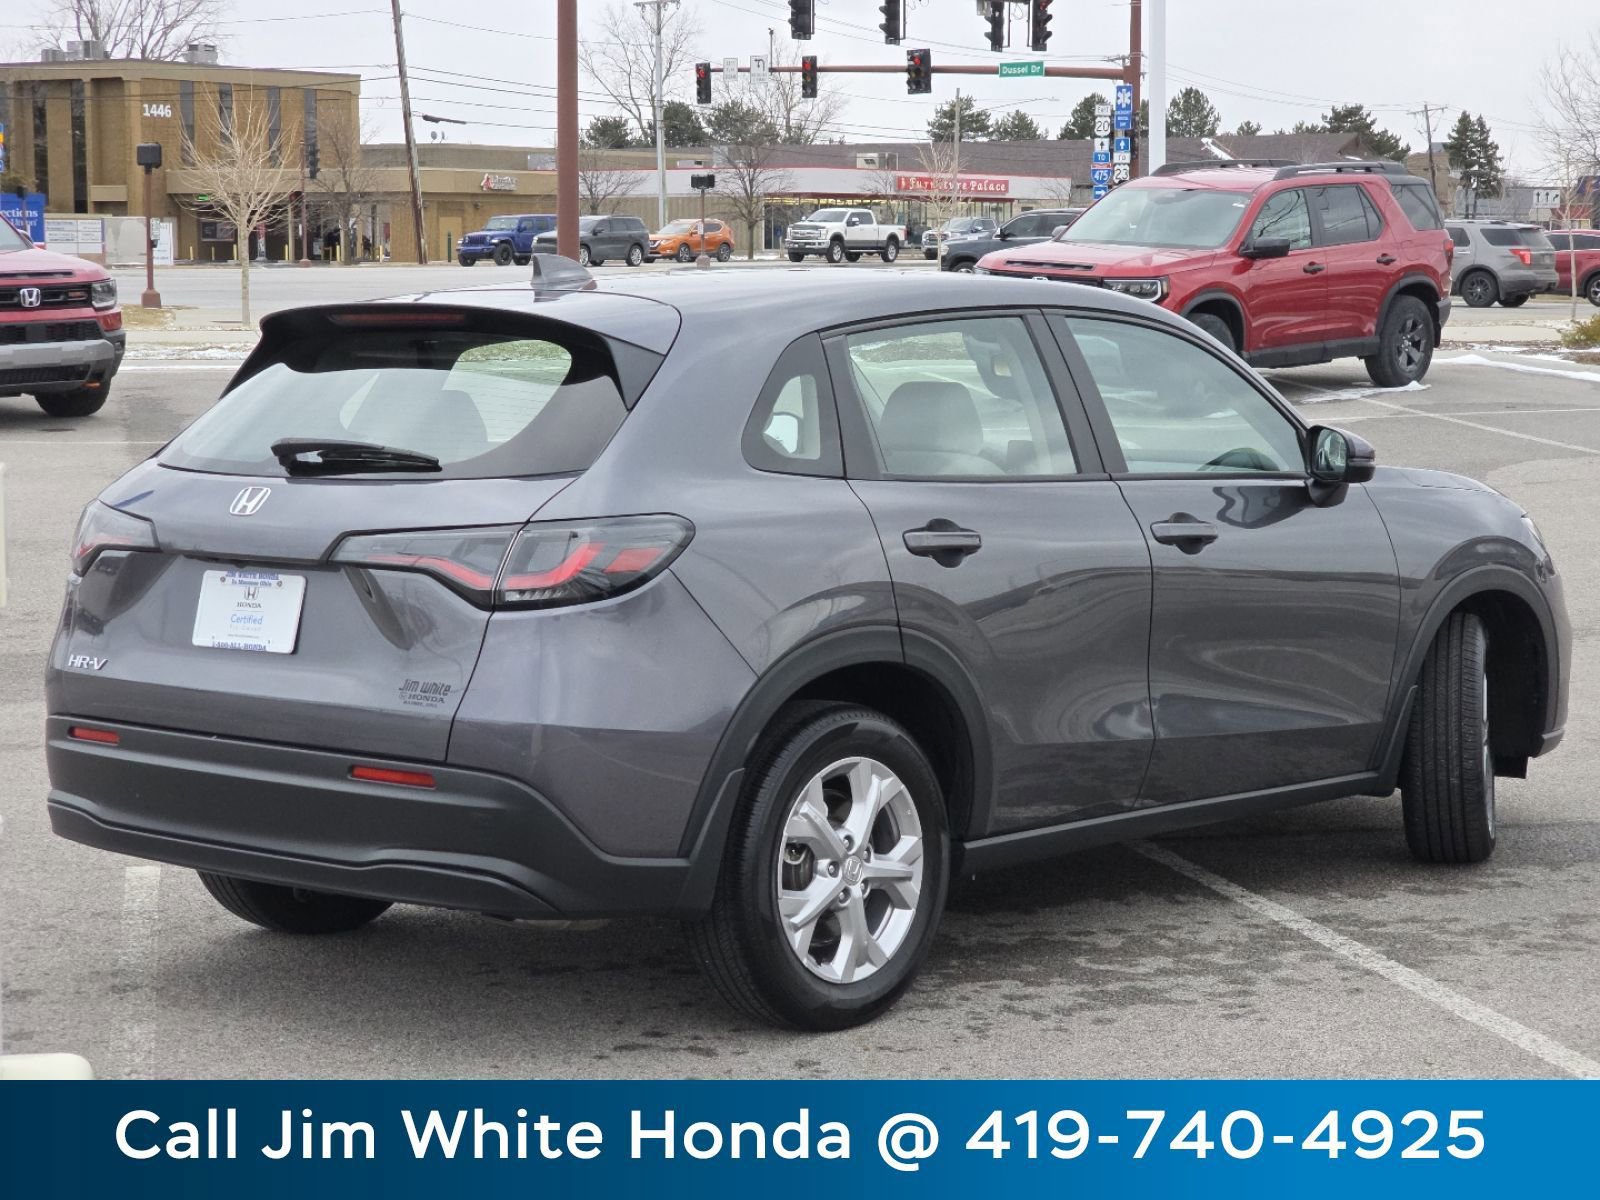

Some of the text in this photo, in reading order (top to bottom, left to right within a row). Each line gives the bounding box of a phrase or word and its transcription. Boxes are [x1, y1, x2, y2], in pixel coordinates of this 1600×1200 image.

[1002, 65, 1041, 75] Dussel Dr
[142, 104, 172, 118] 1446
[1096, 120, 1110, 132] 20
[1097, 153, 1106, 161] TO
[1094, 169, 1108, 179] 475
[1115, 168, 1129, 180] 23
[909, 177, 1006, 191] Furture Palace
[237, 601, 262, 609] HONDA
[230, 613, 264, 625] Certified
[68, 654, 109, 671] HR-V
[399, 679, 420, 692] Jim
[408, 694, 445, 704] HONDA
